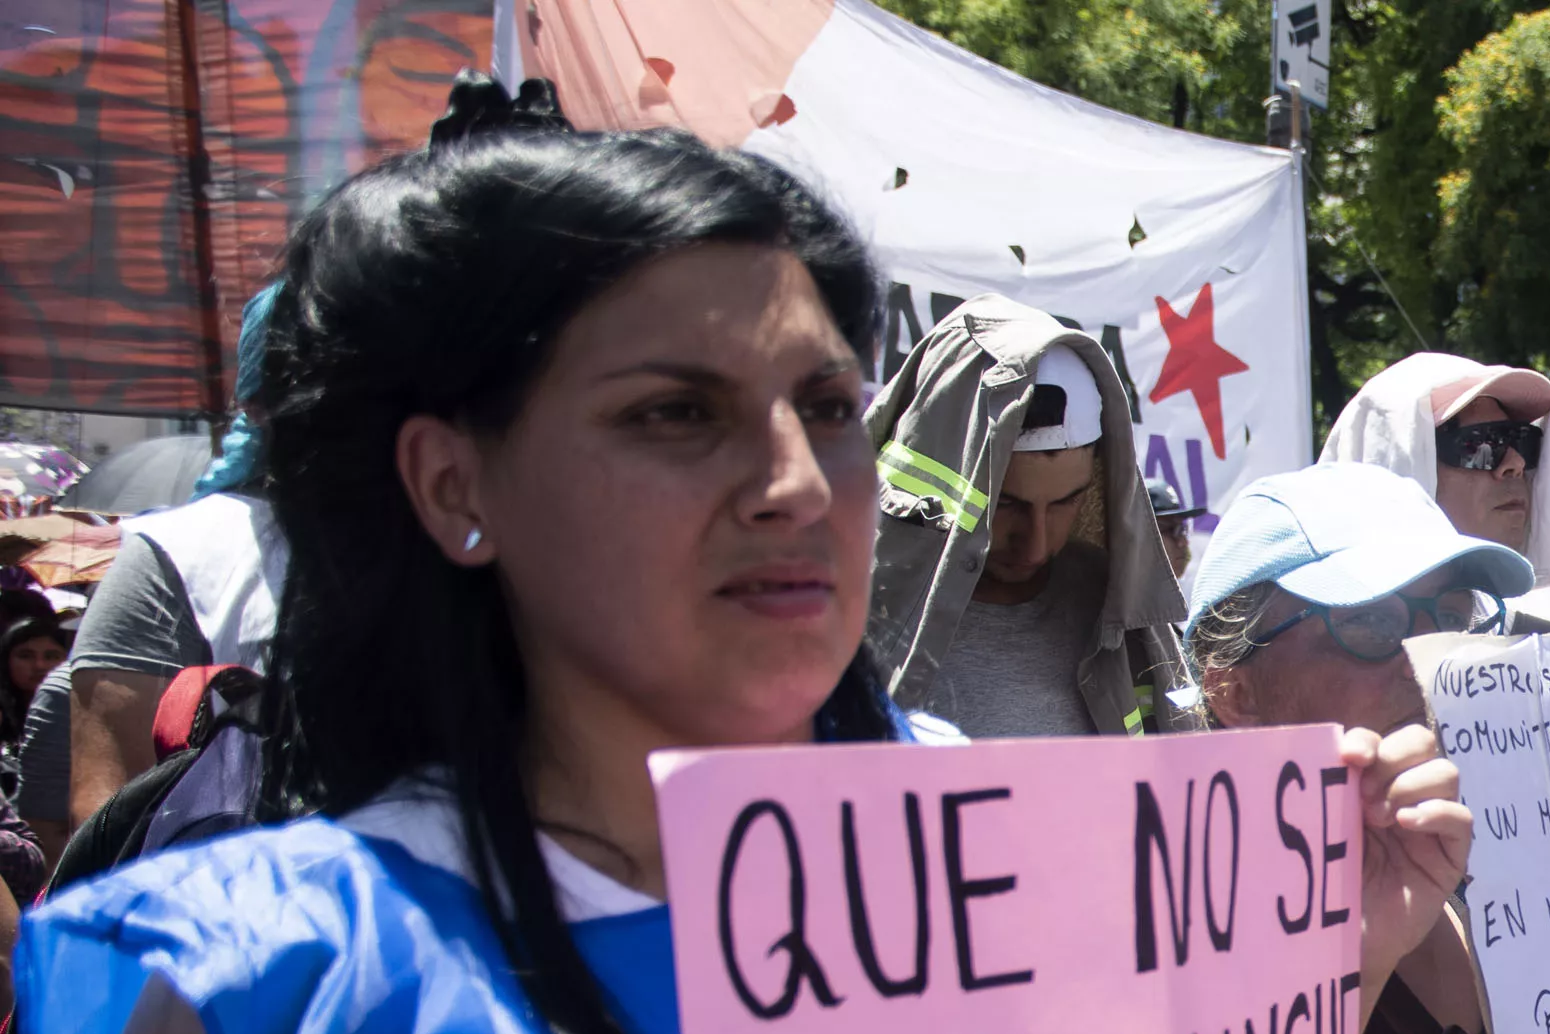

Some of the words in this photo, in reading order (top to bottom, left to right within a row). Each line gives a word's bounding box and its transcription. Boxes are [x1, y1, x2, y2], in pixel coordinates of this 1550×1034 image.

[1484, 804, 1517, 840] UN
[718, 787, 1035, 1020] QUE
[1134, 770, 1241, 974] NO
[1275, 760, 1351, 936] SE
[1483, 888, 1526, 948] EN
